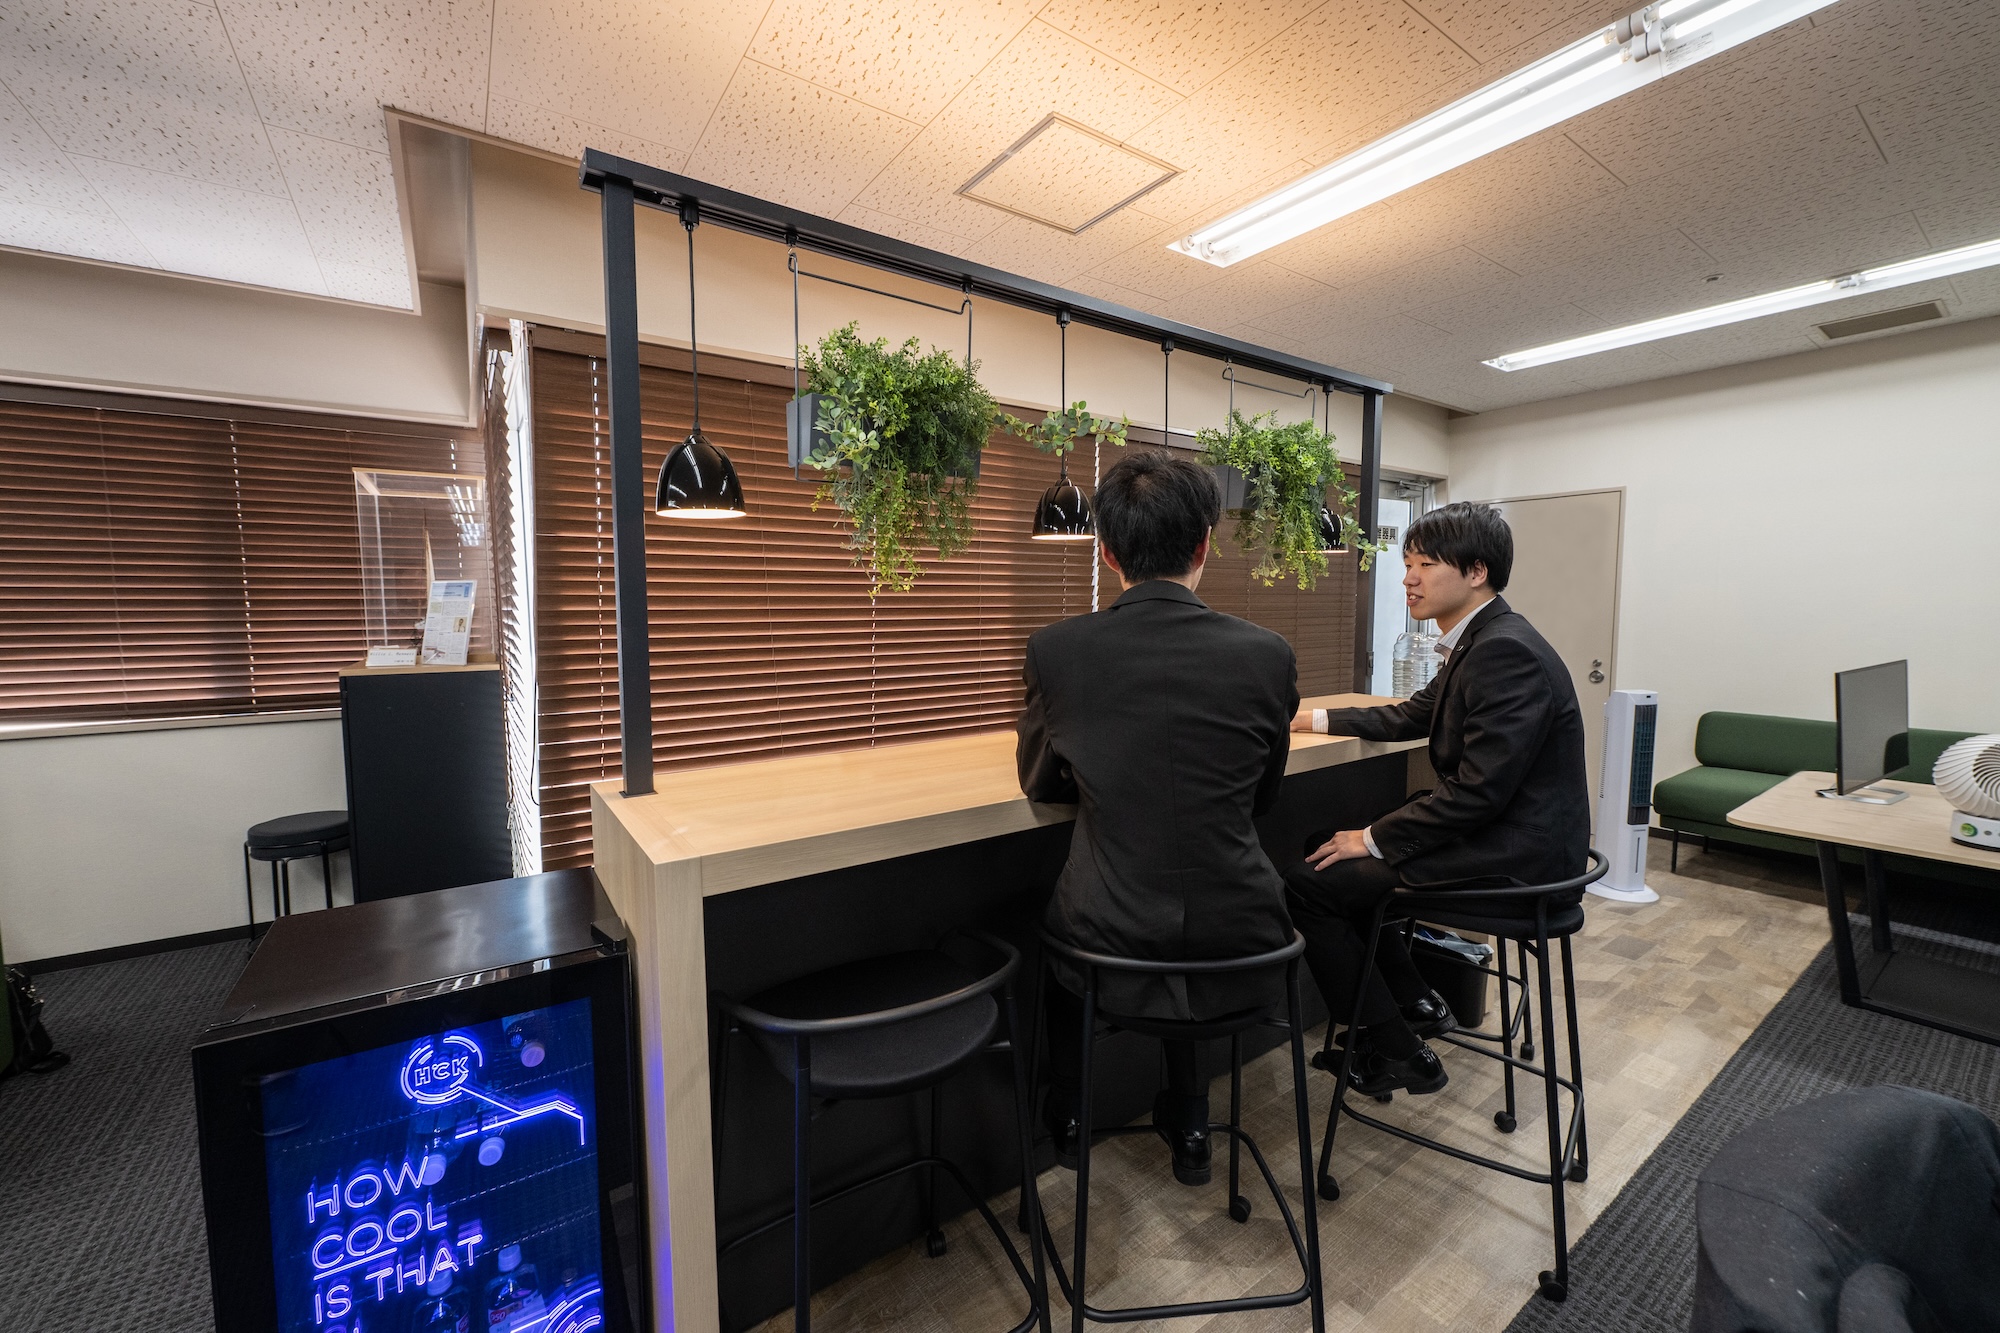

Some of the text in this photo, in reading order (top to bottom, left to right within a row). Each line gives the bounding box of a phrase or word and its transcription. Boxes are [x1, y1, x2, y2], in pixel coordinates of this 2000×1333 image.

[307, 1156, 429, 1224] HOW
[312, 1202, 448, 1269] COOL
[315, 1234, 483, 1324] IS THAT
